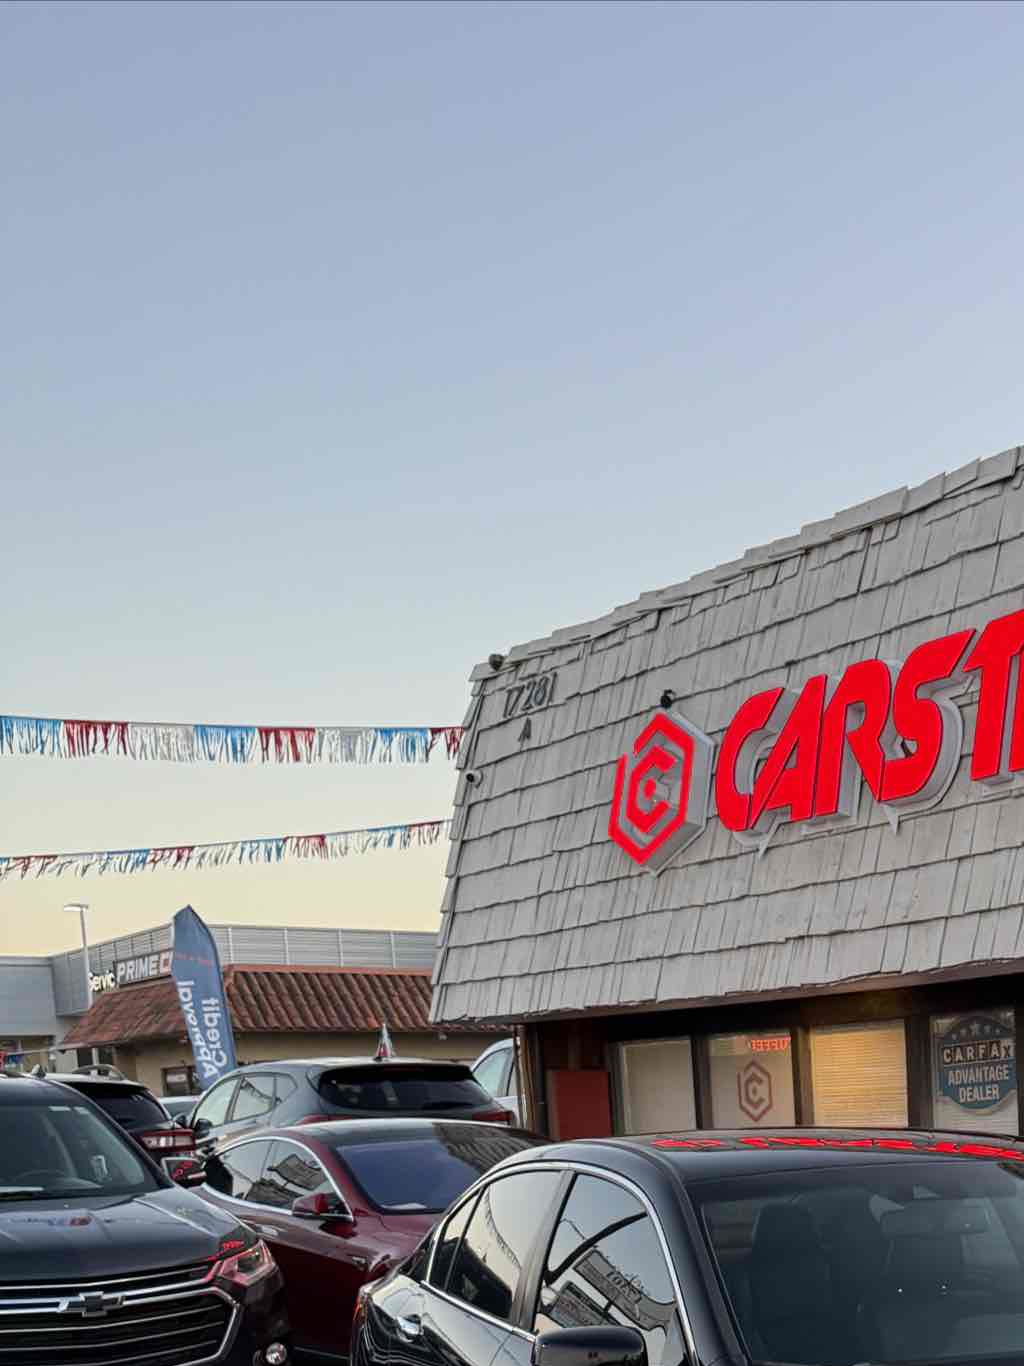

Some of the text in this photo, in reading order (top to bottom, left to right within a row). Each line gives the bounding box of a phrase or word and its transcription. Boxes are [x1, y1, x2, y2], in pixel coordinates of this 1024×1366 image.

[502, 671, 557, 718] 17281
[517, 716, 532, 742] A
[116, 953, 158, 984] PRIME
[943, 1040, 1014, 1063] CARFAX
[947, 1064, 1009, 1086] ADVANTAGE
[959, 1084, 1000, 1103] DEALER
